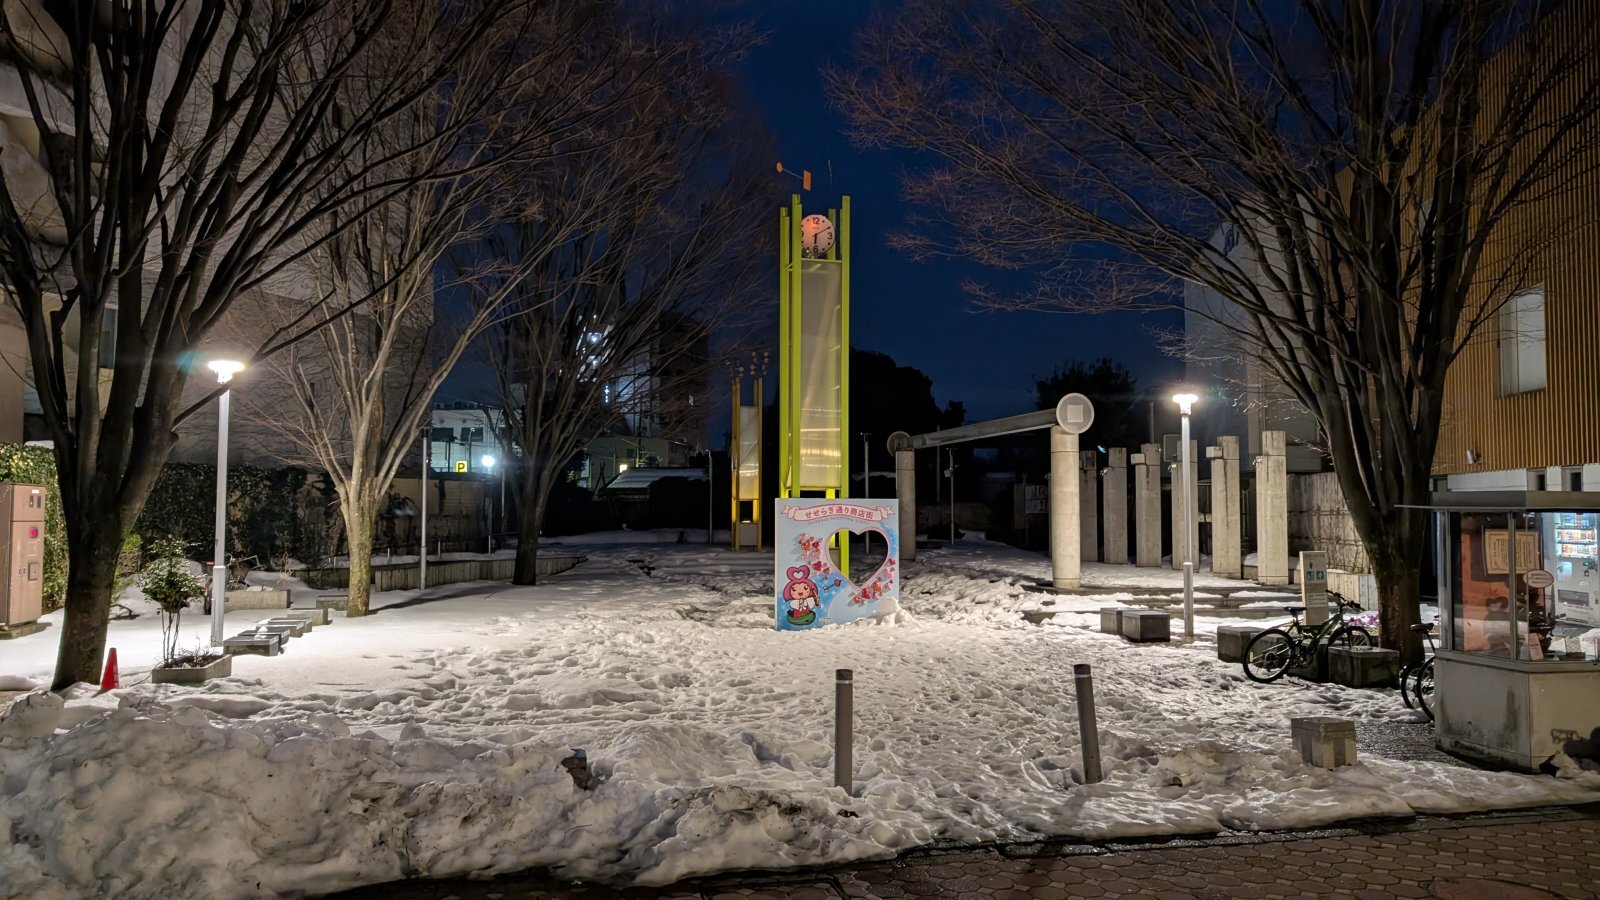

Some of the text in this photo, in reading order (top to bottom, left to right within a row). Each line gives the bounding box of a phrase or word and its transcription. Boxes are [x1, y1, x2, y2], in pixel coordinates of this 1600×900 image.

[827, 232, 832, 240] 3
[458, 462, 465, 473] P
[805, 505, 874, 519] せせらぎ通り商店街
